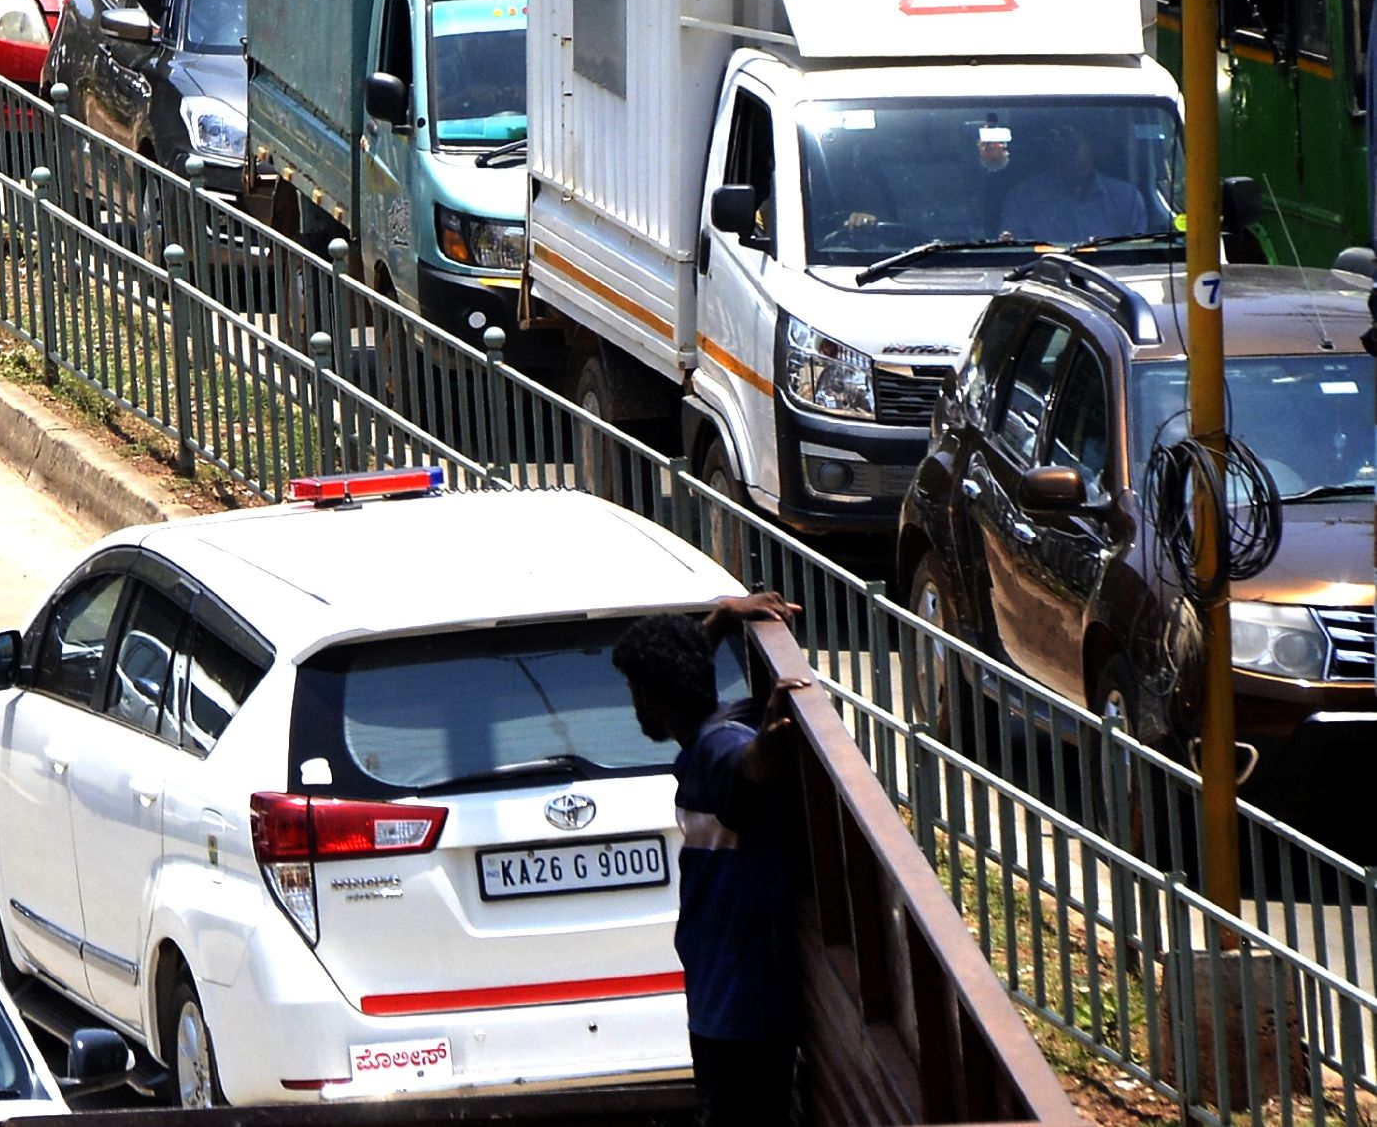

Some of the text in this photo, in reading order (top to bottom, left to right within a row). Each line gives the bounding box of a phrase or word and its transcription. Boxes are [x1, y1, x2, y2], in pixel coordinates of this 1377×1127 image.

[1202, 278, 1220, 305] 7
[501, 847, 659, 886] KA26 G 9000
[356, 1042, 447, 1071] ಪೊಲೀಸ್
